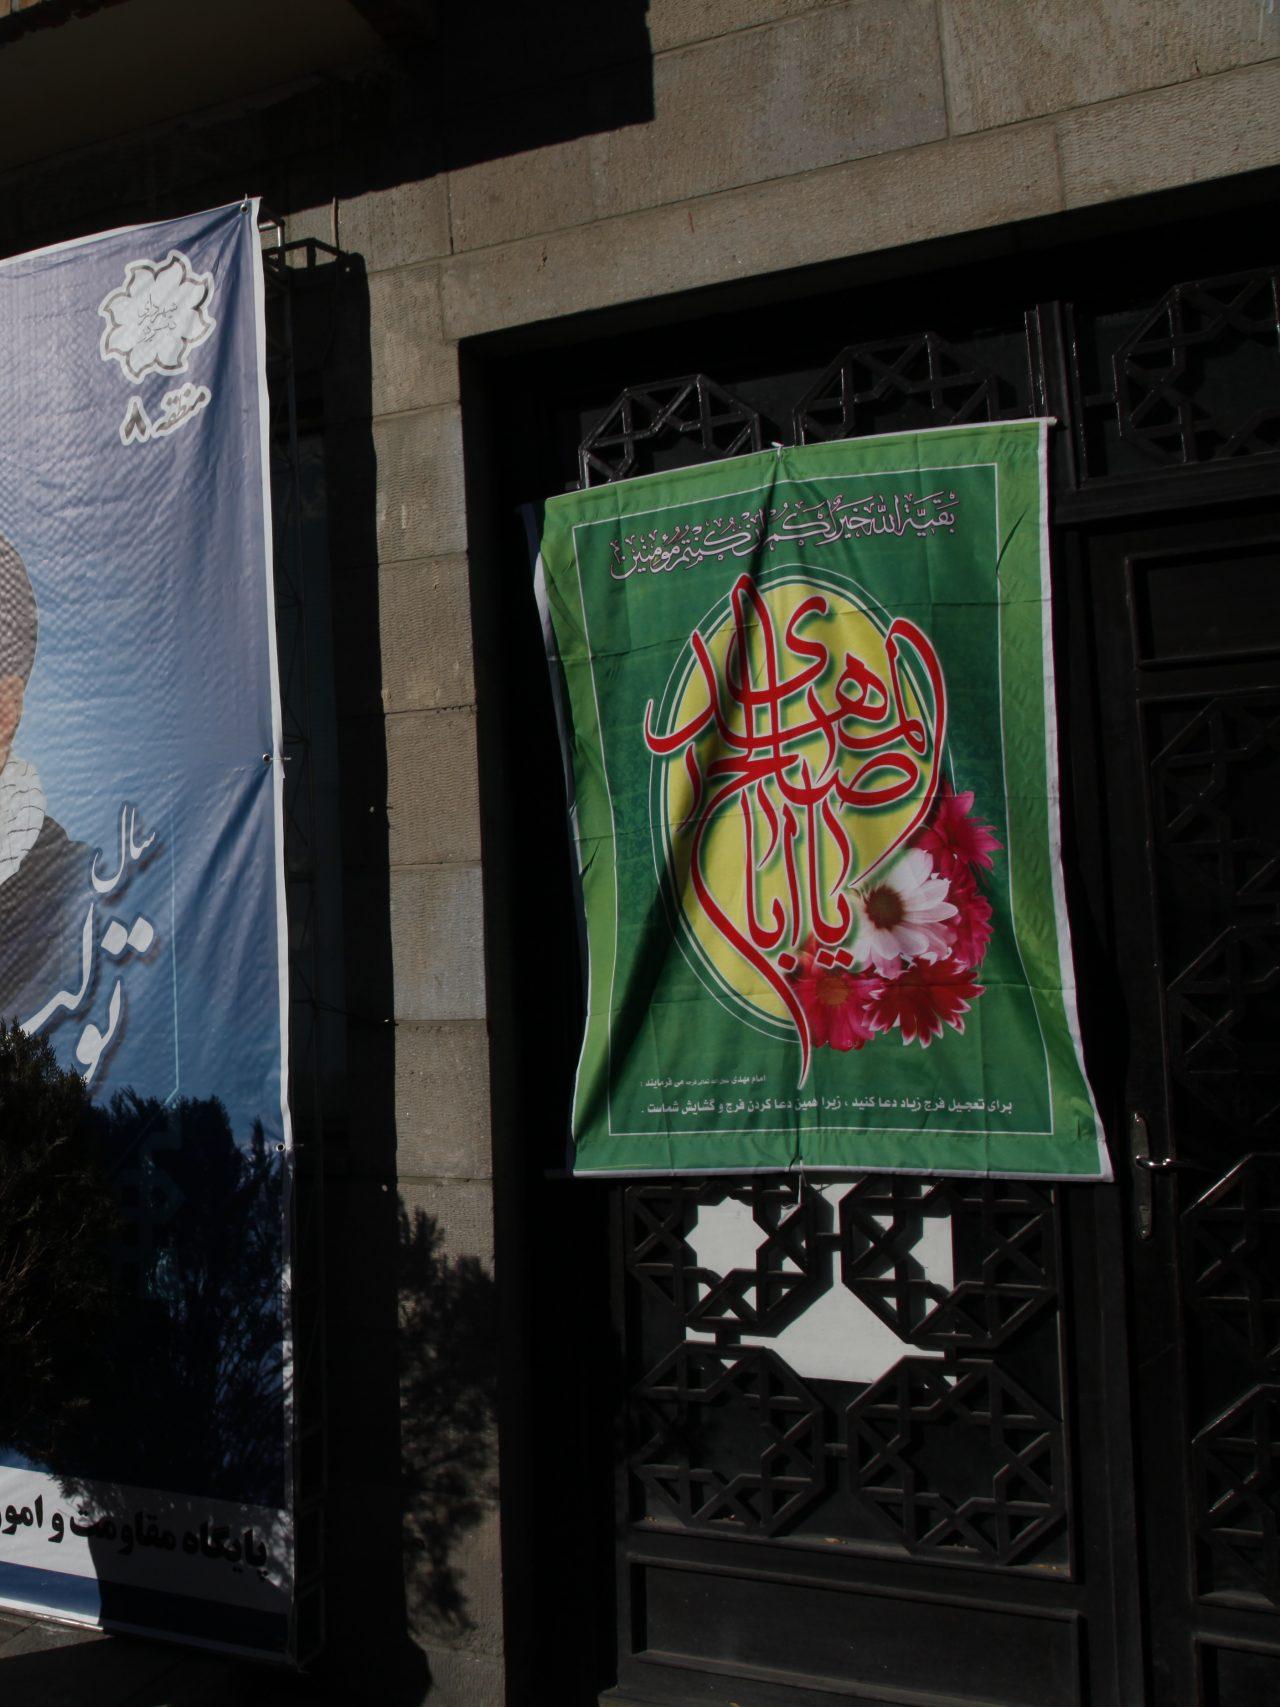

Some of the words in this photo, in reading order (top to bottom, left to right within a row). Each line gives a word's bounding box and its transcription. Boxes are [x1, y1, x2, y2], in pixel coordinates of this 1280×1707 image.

[153, 384, 209, 435] منطقه
[122, 398, 149, 442] ۸
[90, 805, 156, 894] سال
[681, 1098, 716, 1115] گشایش
[725, 1099, 745, 1113] فرج
[747, 1098, 771, 1113] کردن
[774, 1098, 792, 1109] دعا
[794, 1098, 817, 1111] همین
[821, 1095, 841, 1110] زیرا
[878, 1097, 897, 1107] دعا
[900, 1096, 921, 1112] زیاد
[923, 1097, 945, 1112] فرج
[948, 1098, 985, 1112] تعجیل
[988, 1099, 1012, 1114] برای
[48, 1512, 65, 1543] و
[68, 1504, 178, 1555] مقاومت
[182, 1524, 269, 1580] پایگاه
